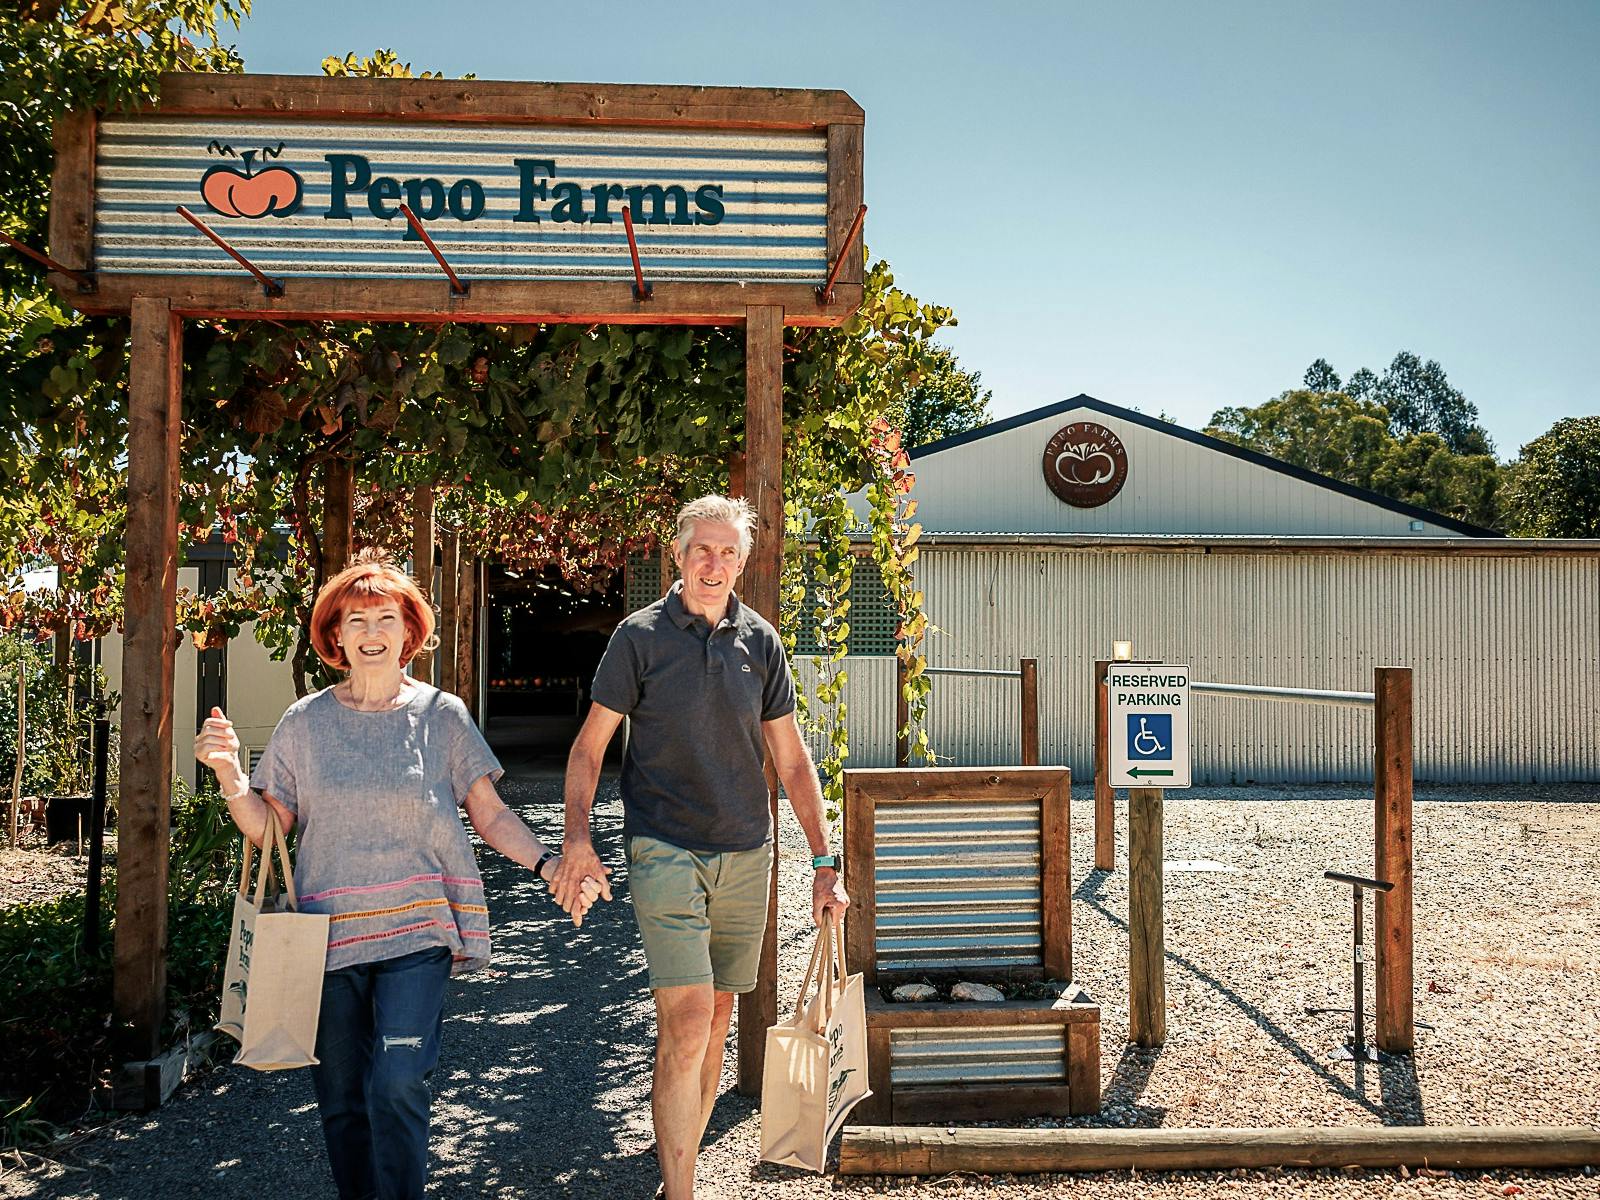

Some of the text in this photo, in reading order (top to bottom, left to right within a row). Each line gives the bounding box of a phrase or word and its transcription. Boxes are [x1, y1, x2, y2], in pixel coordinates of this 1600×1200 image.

[324, 154, 725, 241] Pepo Farms
[1046, 424, 1124, 456] PEPO FARMS
[1112, 674, 1187, 688] RESERVED
[1118, 693, 1181, 706] PARKING
